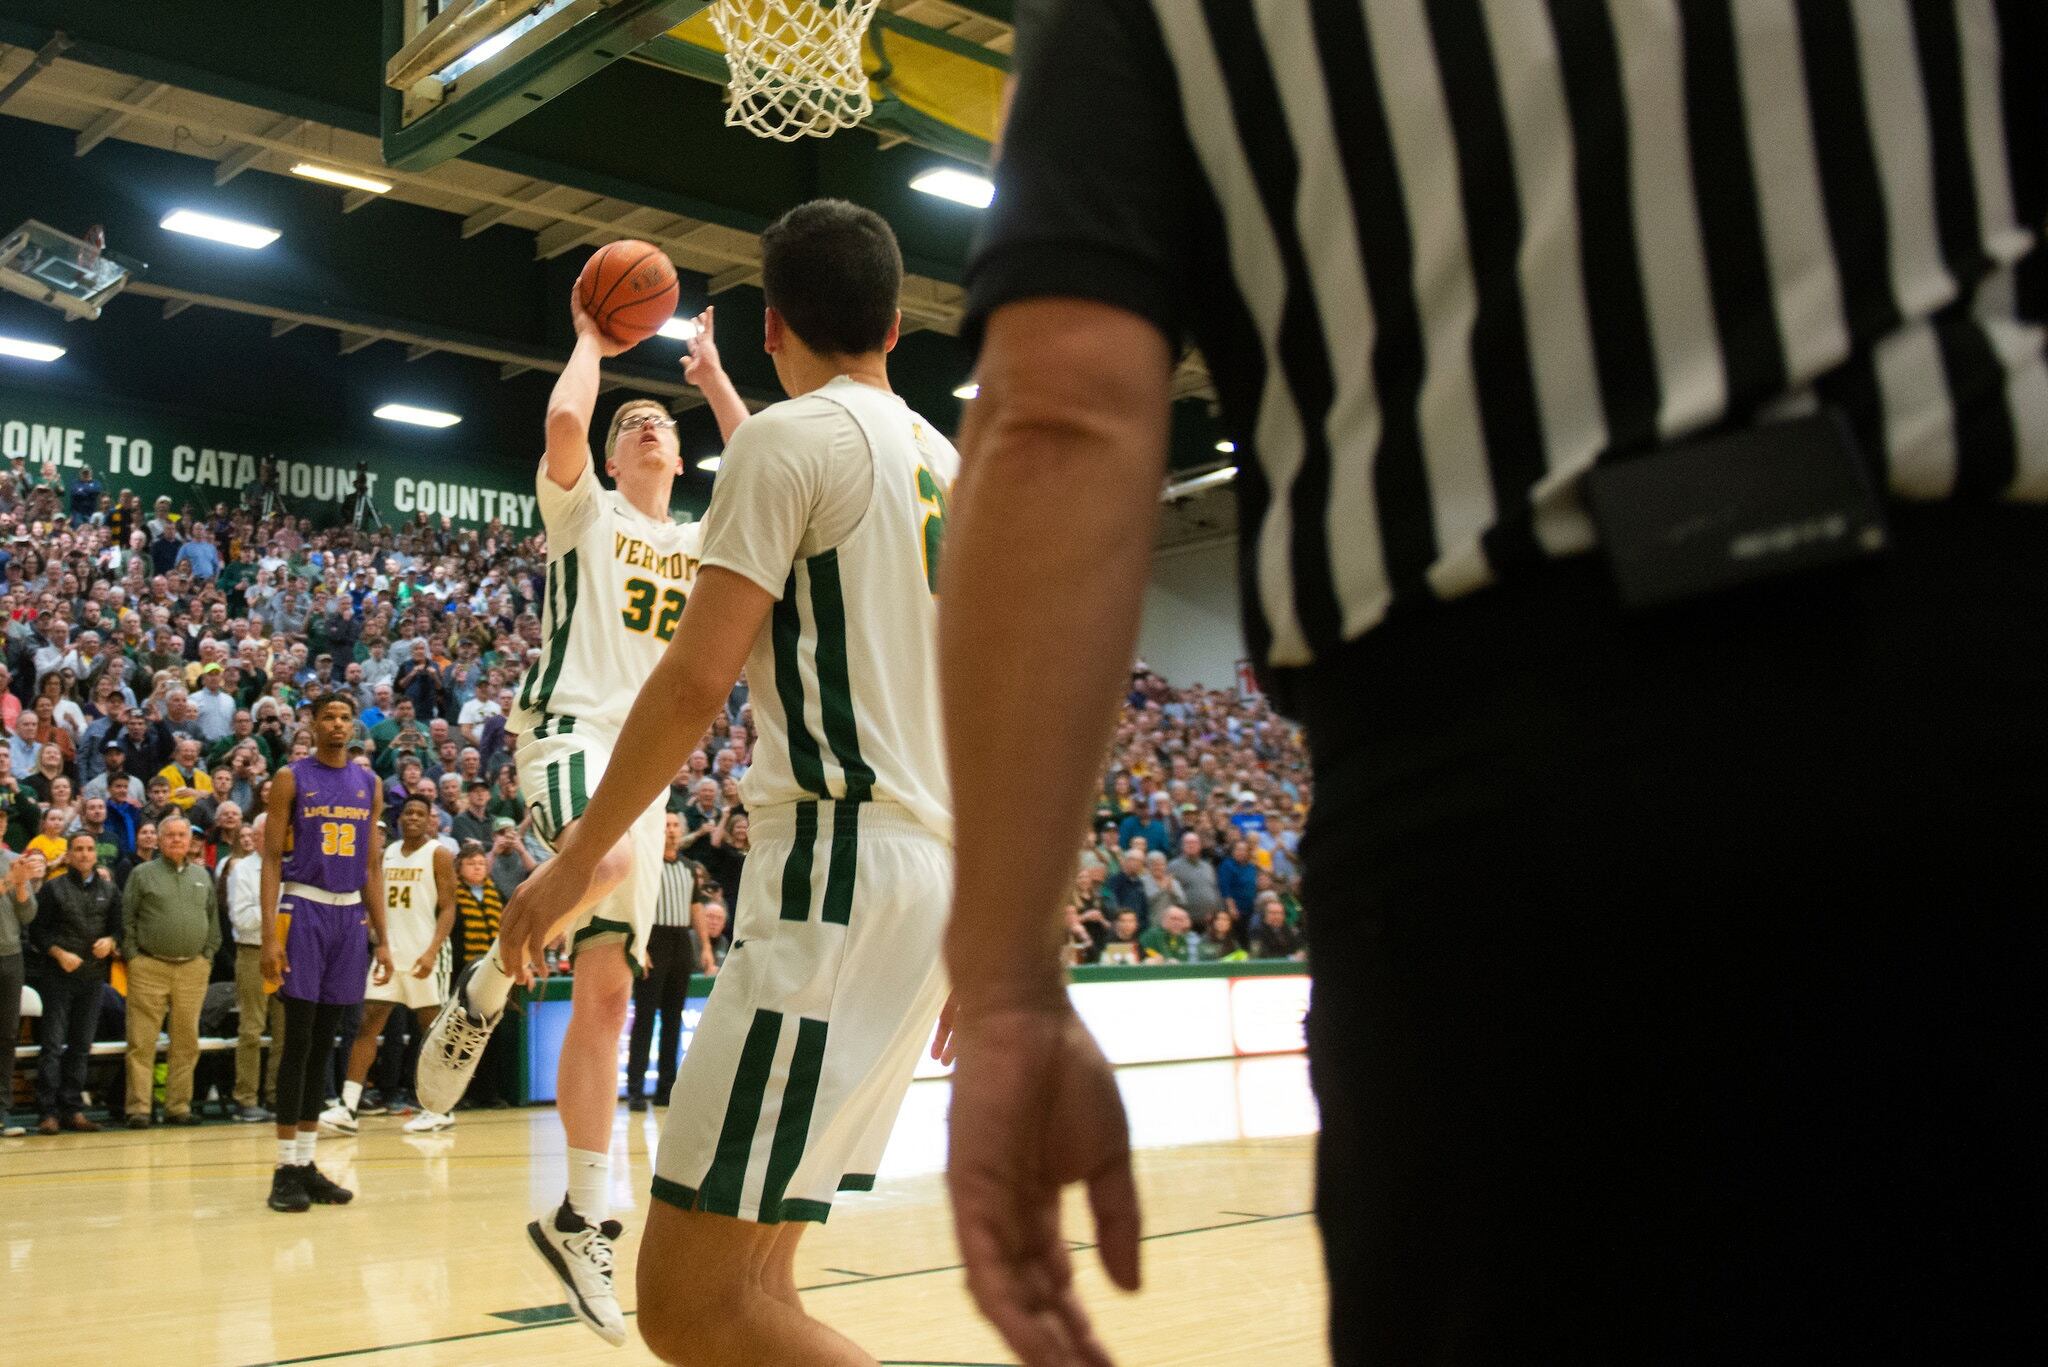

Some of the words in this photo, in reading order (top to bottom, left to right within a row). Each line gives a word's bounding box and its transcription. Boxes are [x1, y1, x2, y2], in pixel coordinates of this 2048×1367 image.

[0, 420, 85, 468] OME
[105, 434, 153, 477] TO
[394, 476, 538, 528] COUNTRY
[620, 576, 687, 642] 32
[321, 822, 356, 856] 32
[388, 886, 411, 909] 24
